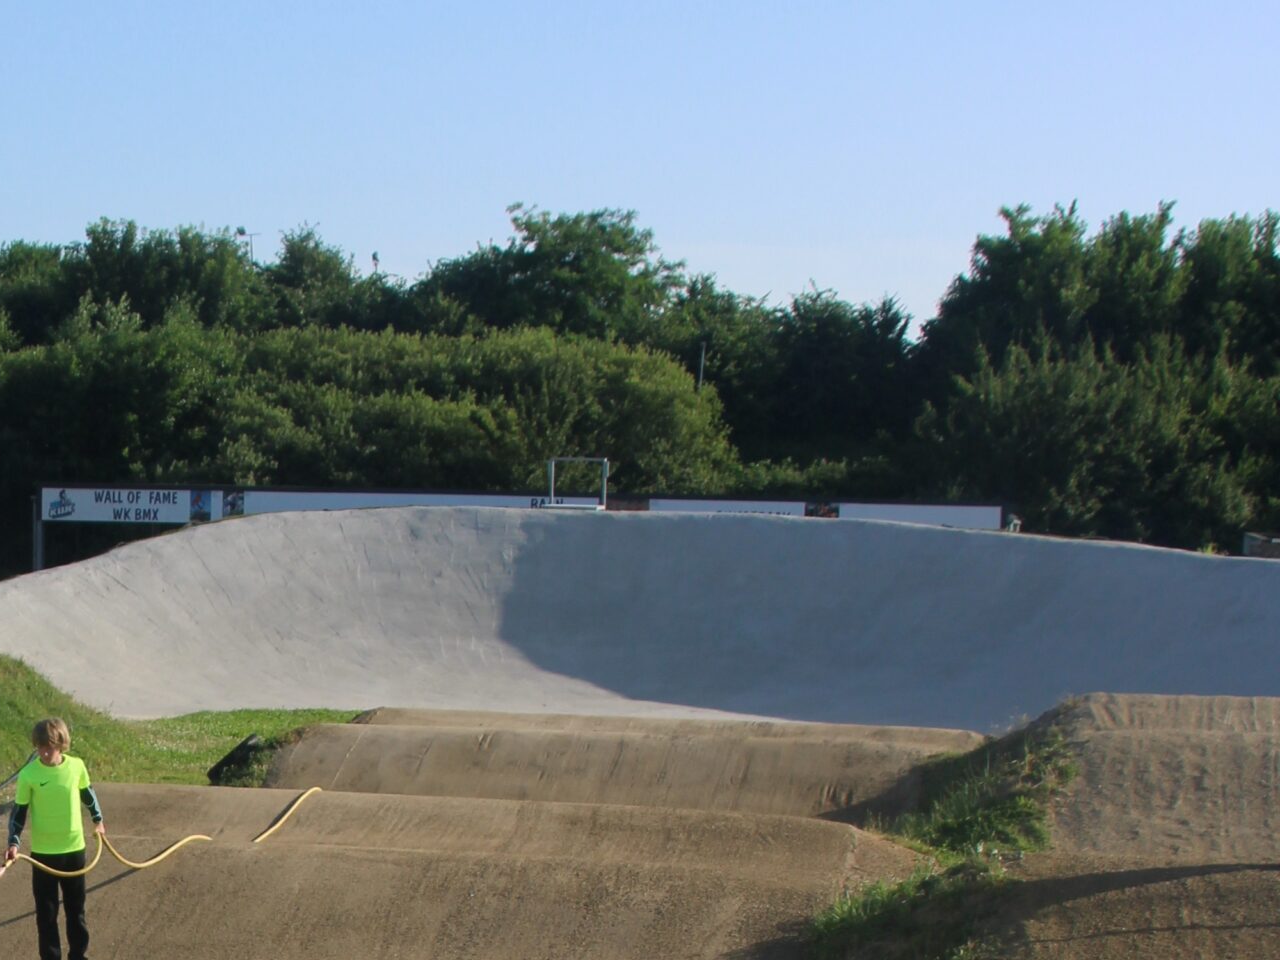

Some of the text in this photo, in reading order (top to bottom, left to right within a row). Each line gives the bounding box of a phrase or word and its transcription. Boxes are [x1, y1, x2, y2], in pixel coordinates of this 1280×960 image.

[94, 490, 178, 505] WALL OF FAME
[113, 508, 159, 521] WK BMX
